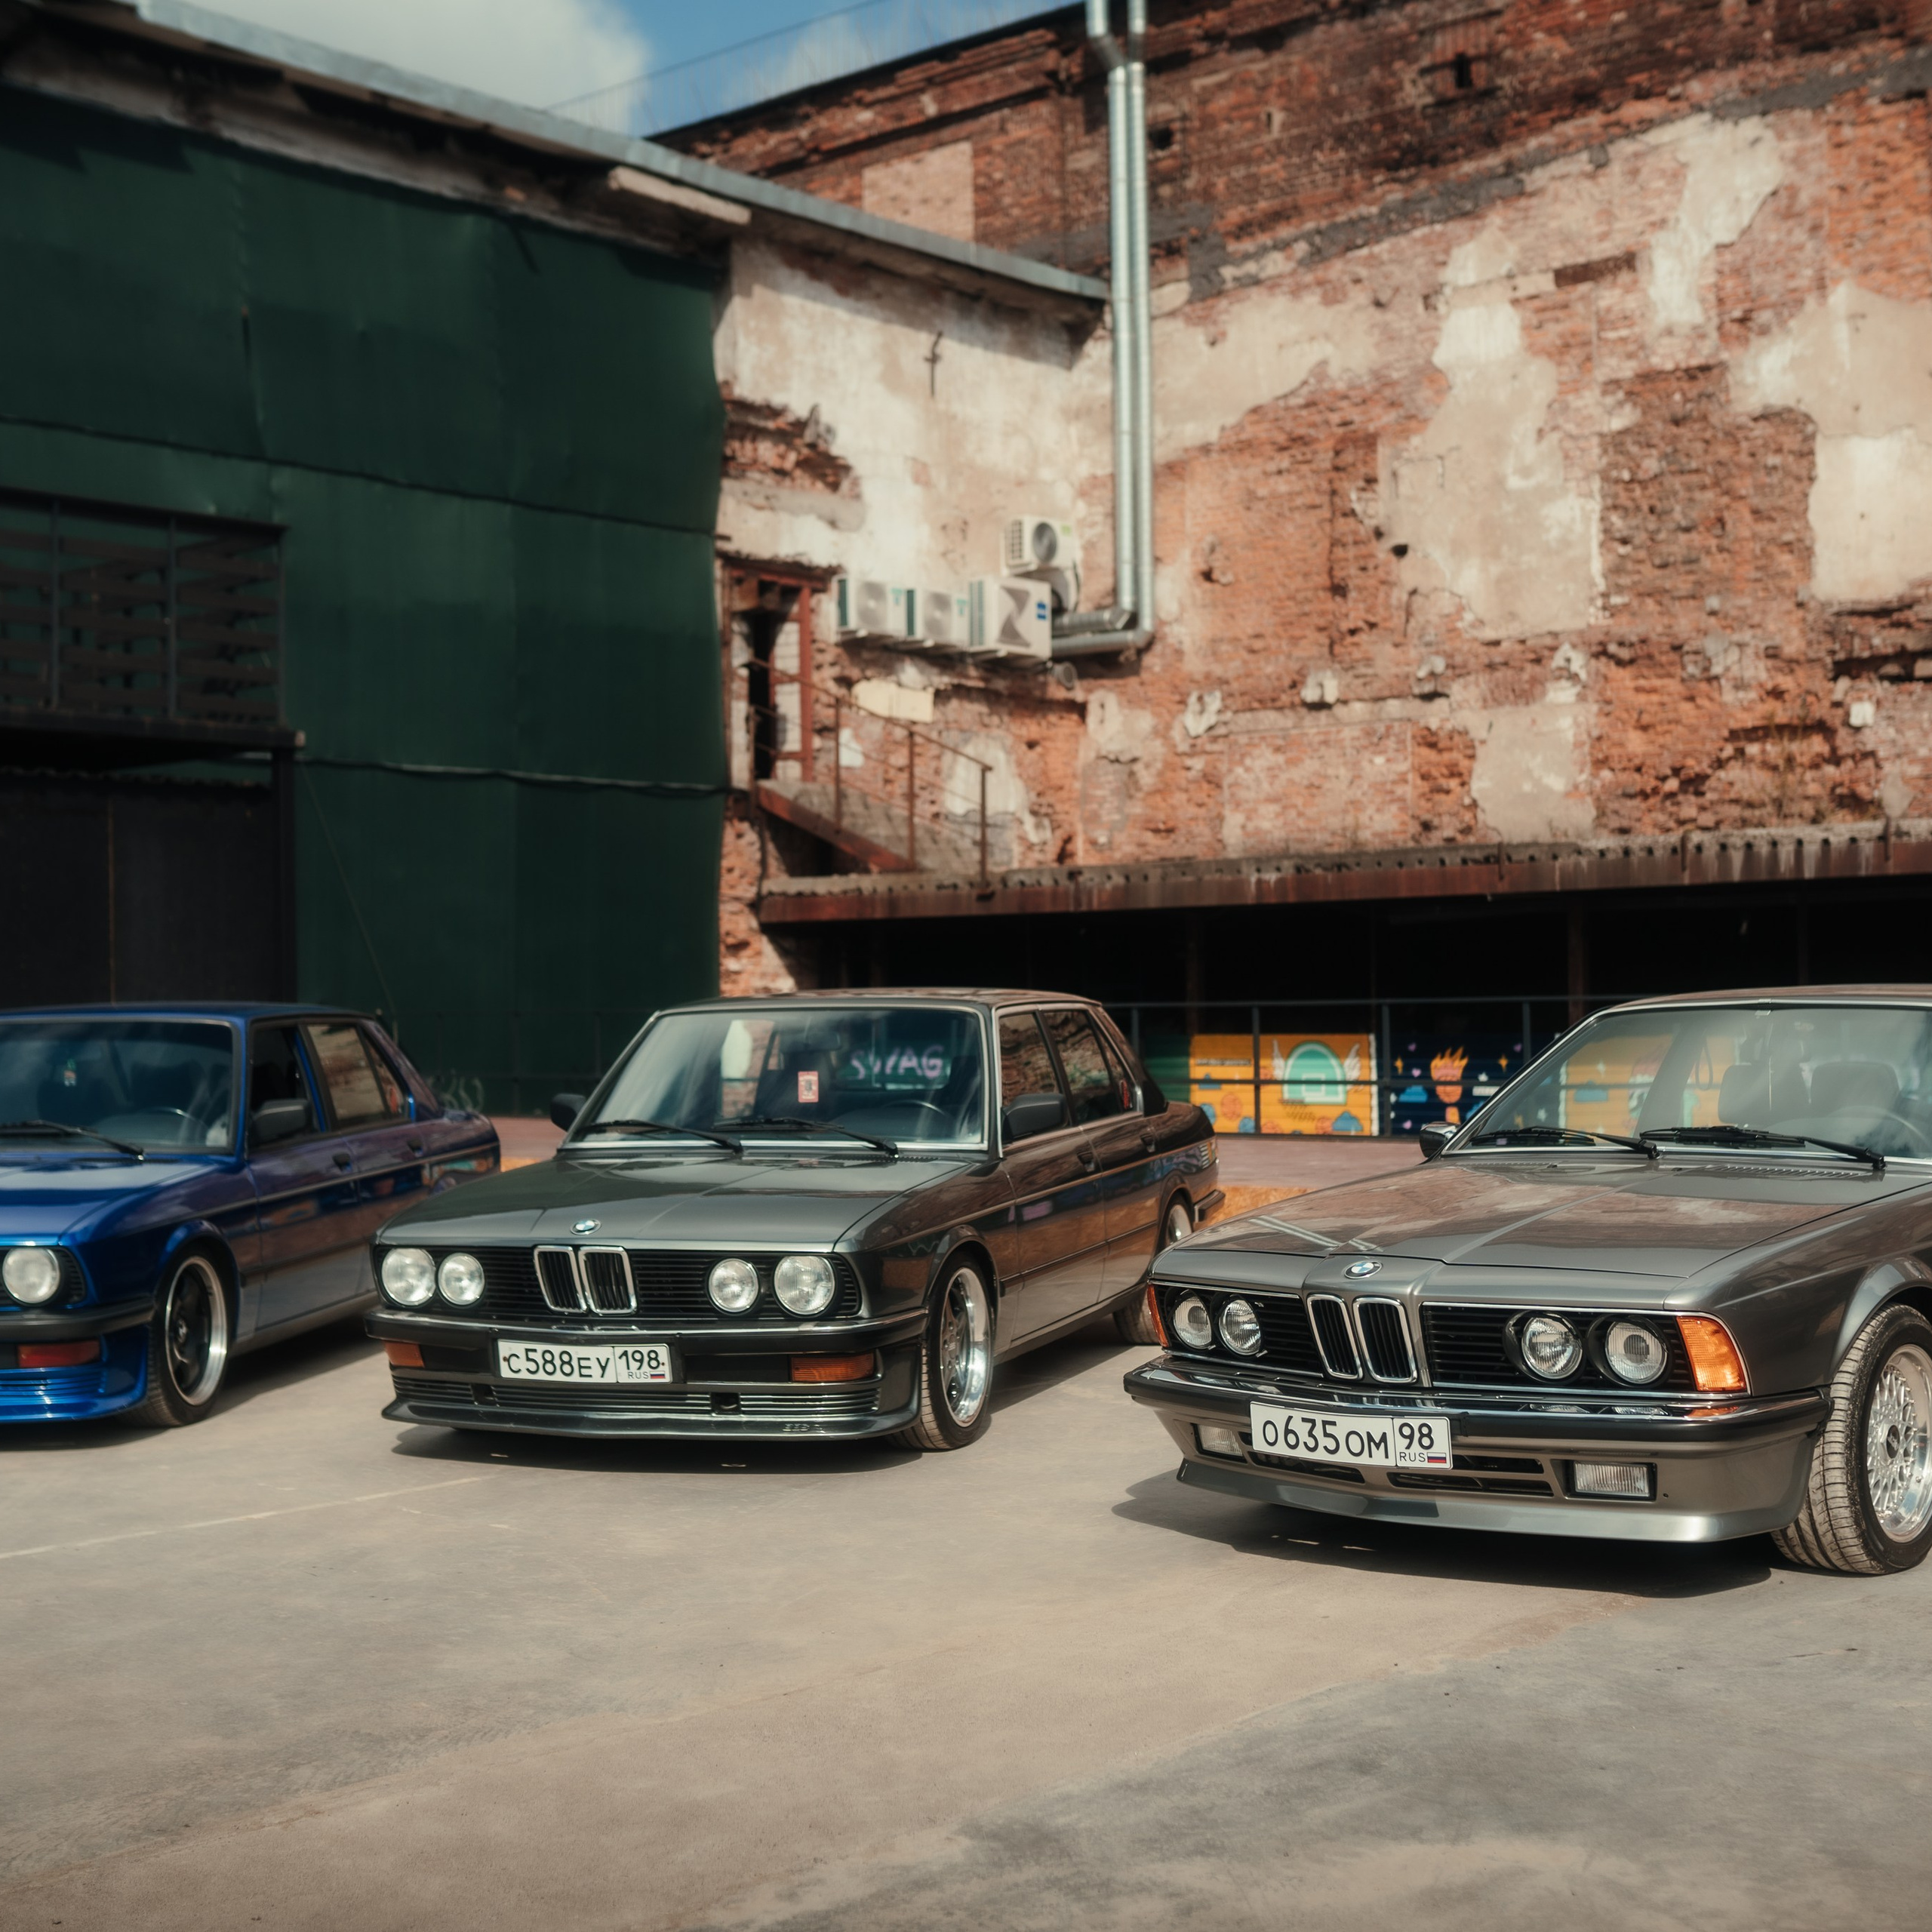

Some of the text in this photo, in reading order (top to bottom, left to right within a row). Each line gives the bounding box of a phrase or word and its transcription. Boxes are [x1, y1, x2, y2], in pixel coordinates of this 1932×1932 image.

[618, 1349, 660, 1371] 198
[1398, 1423, 1434, 1450] 98
[1400, 1452, 1426, 1462] RUS
